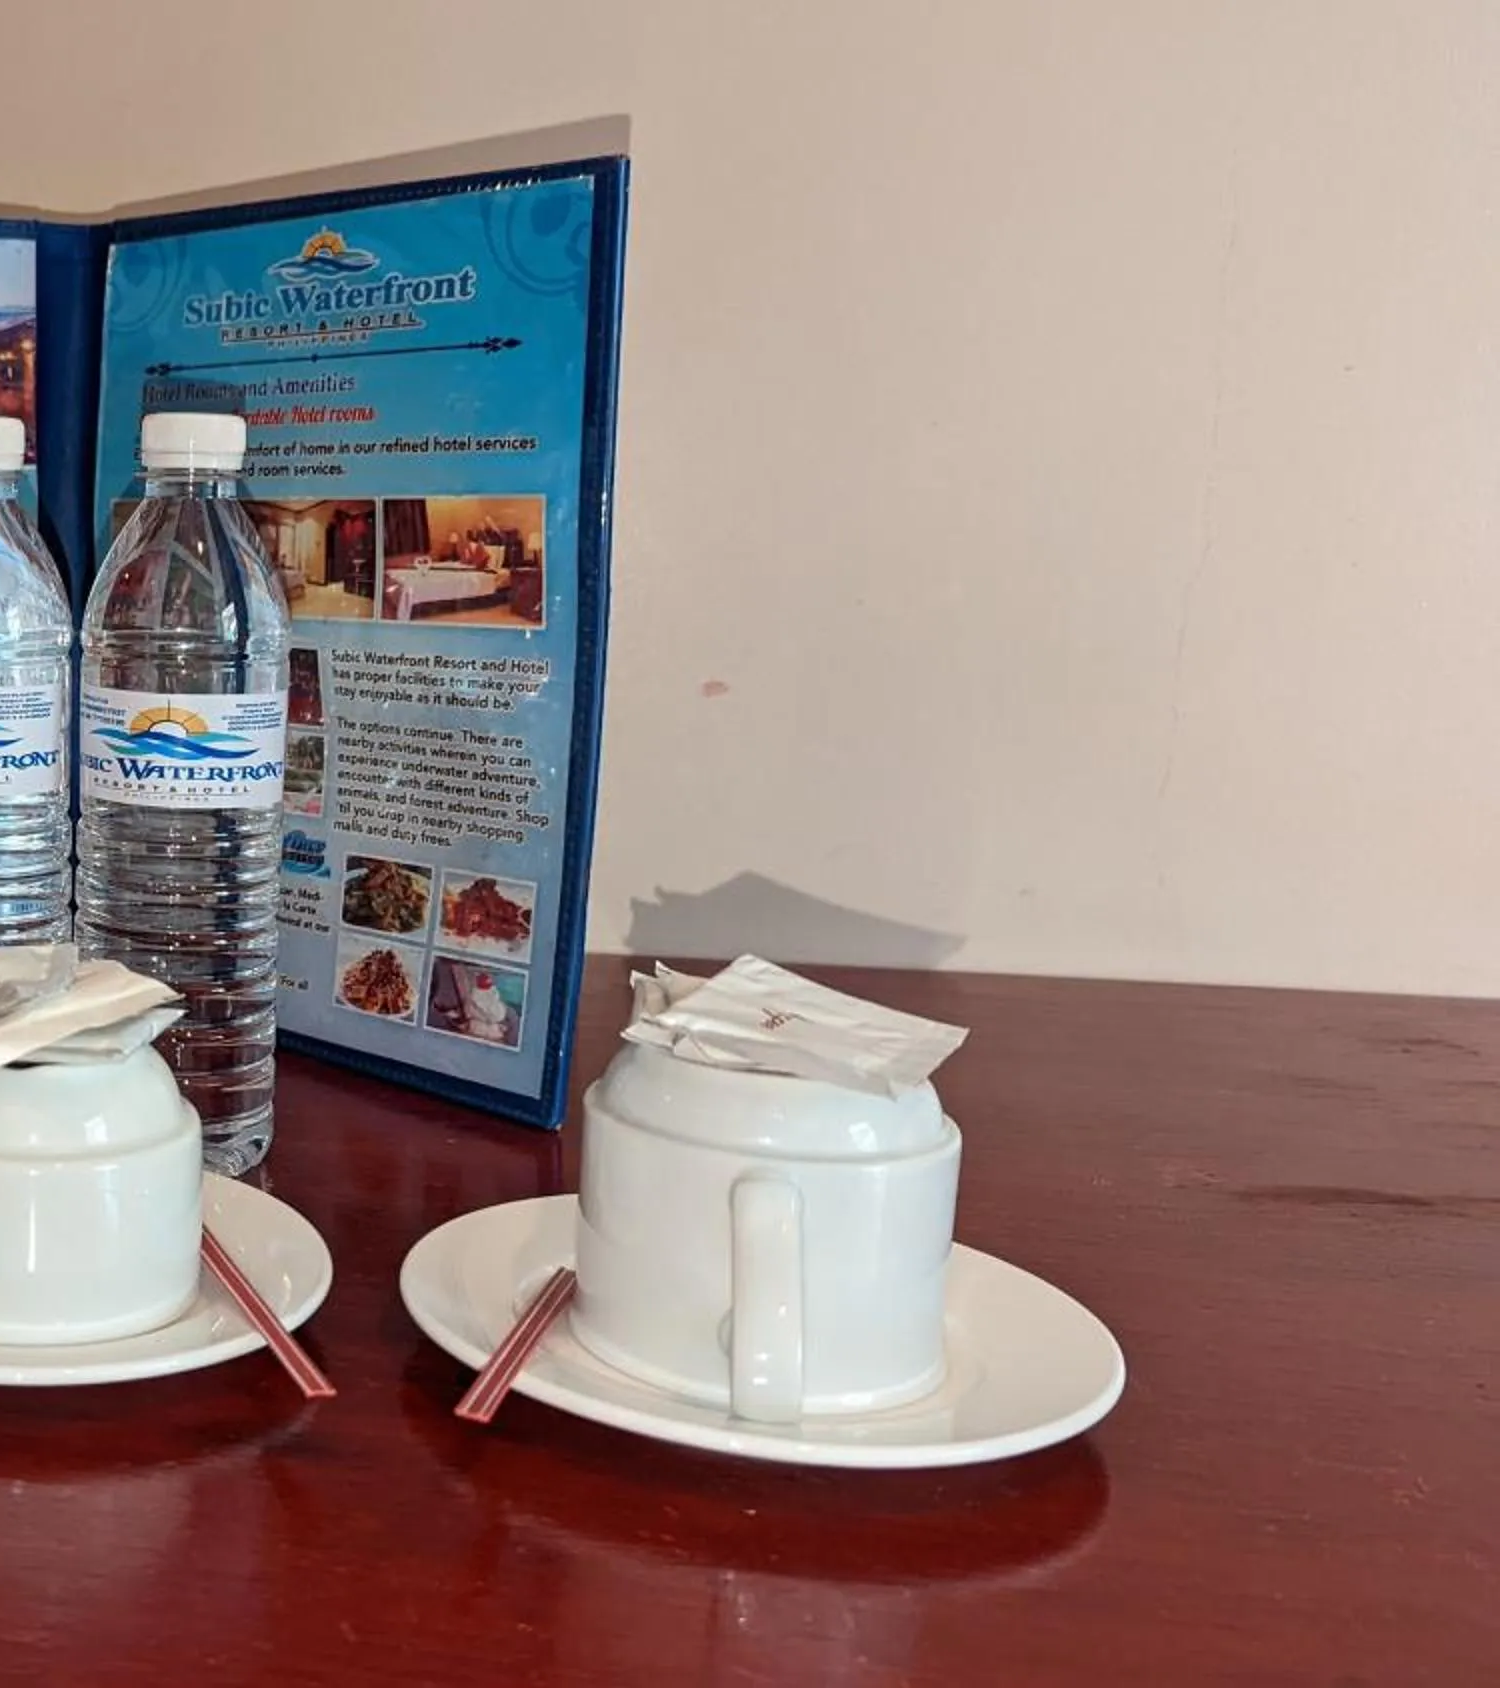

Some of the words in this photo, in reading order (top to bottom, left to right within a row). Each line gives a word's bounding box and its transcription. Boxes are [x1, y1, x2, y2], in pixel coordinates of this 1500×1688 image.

[185, 293, 269, 325] Subic
[279, 269, 475, 314] Waterfront
[221, 323, 302, 342] RESORT
[319, 320, 328, 331] &
[343, 311, 418, 329] HOTEL
[273, 374, 356, 395] Amenities
[284, 440, 298, 457] of
[301, 440, 335, 457] home
[338, 439, 351, 455] in
[353, 441, 377, 455] our
[380, 436, 429, 454] refined
[433, 435, 472, 452] hotel
[475, 436, 536, 451] services
[258, 463, 290, 477] room
[331, 649, 360, 663] Subic
[364, 650, 429, 668] Waterfront
[434, 655, 477, 671] Resort
[481, 657, 507, 673] and
[512, 659, 549, 675] Hotel
[354, 671, 392, 684] proper
[467, 676, 504, 691] make
[507, 682, 541, 696] your
[334, 686, 356, 700] stay
[359, 688, 413, 703] enjoyable
[418, 693, 430, 704] as
[434, 691, 443, 705] it
[446, 692, 490, 708] should
[337, 716, 357, 730] The
[360, 721, 401, 735] options
[462, 729, 498, 747] There
[502, 735, 524, 749] are
[338, 736, 376, 752] nearby
[379, 741, 427, 757] activities
[430, 745, 478, 762] wherein
[481, 754, 506, 768] you
[509, 757, 532, 769] can
[116, 758, 284, 783] WATERFRONT
[338, 754, 399, 770] experience
[401, 760, 469, 779] underwater
[187, 786, 251, 795] HOTEL
[424, 779, 476, 798] different
[479, 785, 512, 804] kinds
[515, 791, 529, 805] of
[385, 792, 408, 806] and
[410, 794, 444, 812] forest
[515, 808, 550, 828] Shop
[333, 819, 363, 833] malls
[366, 824, 389, 838] and
[353, 807, 375, 819] you
[409, 812, 420, 825] in
[422, 816, 463, 834] nearby
[466, 820, 525, 844] shopping
